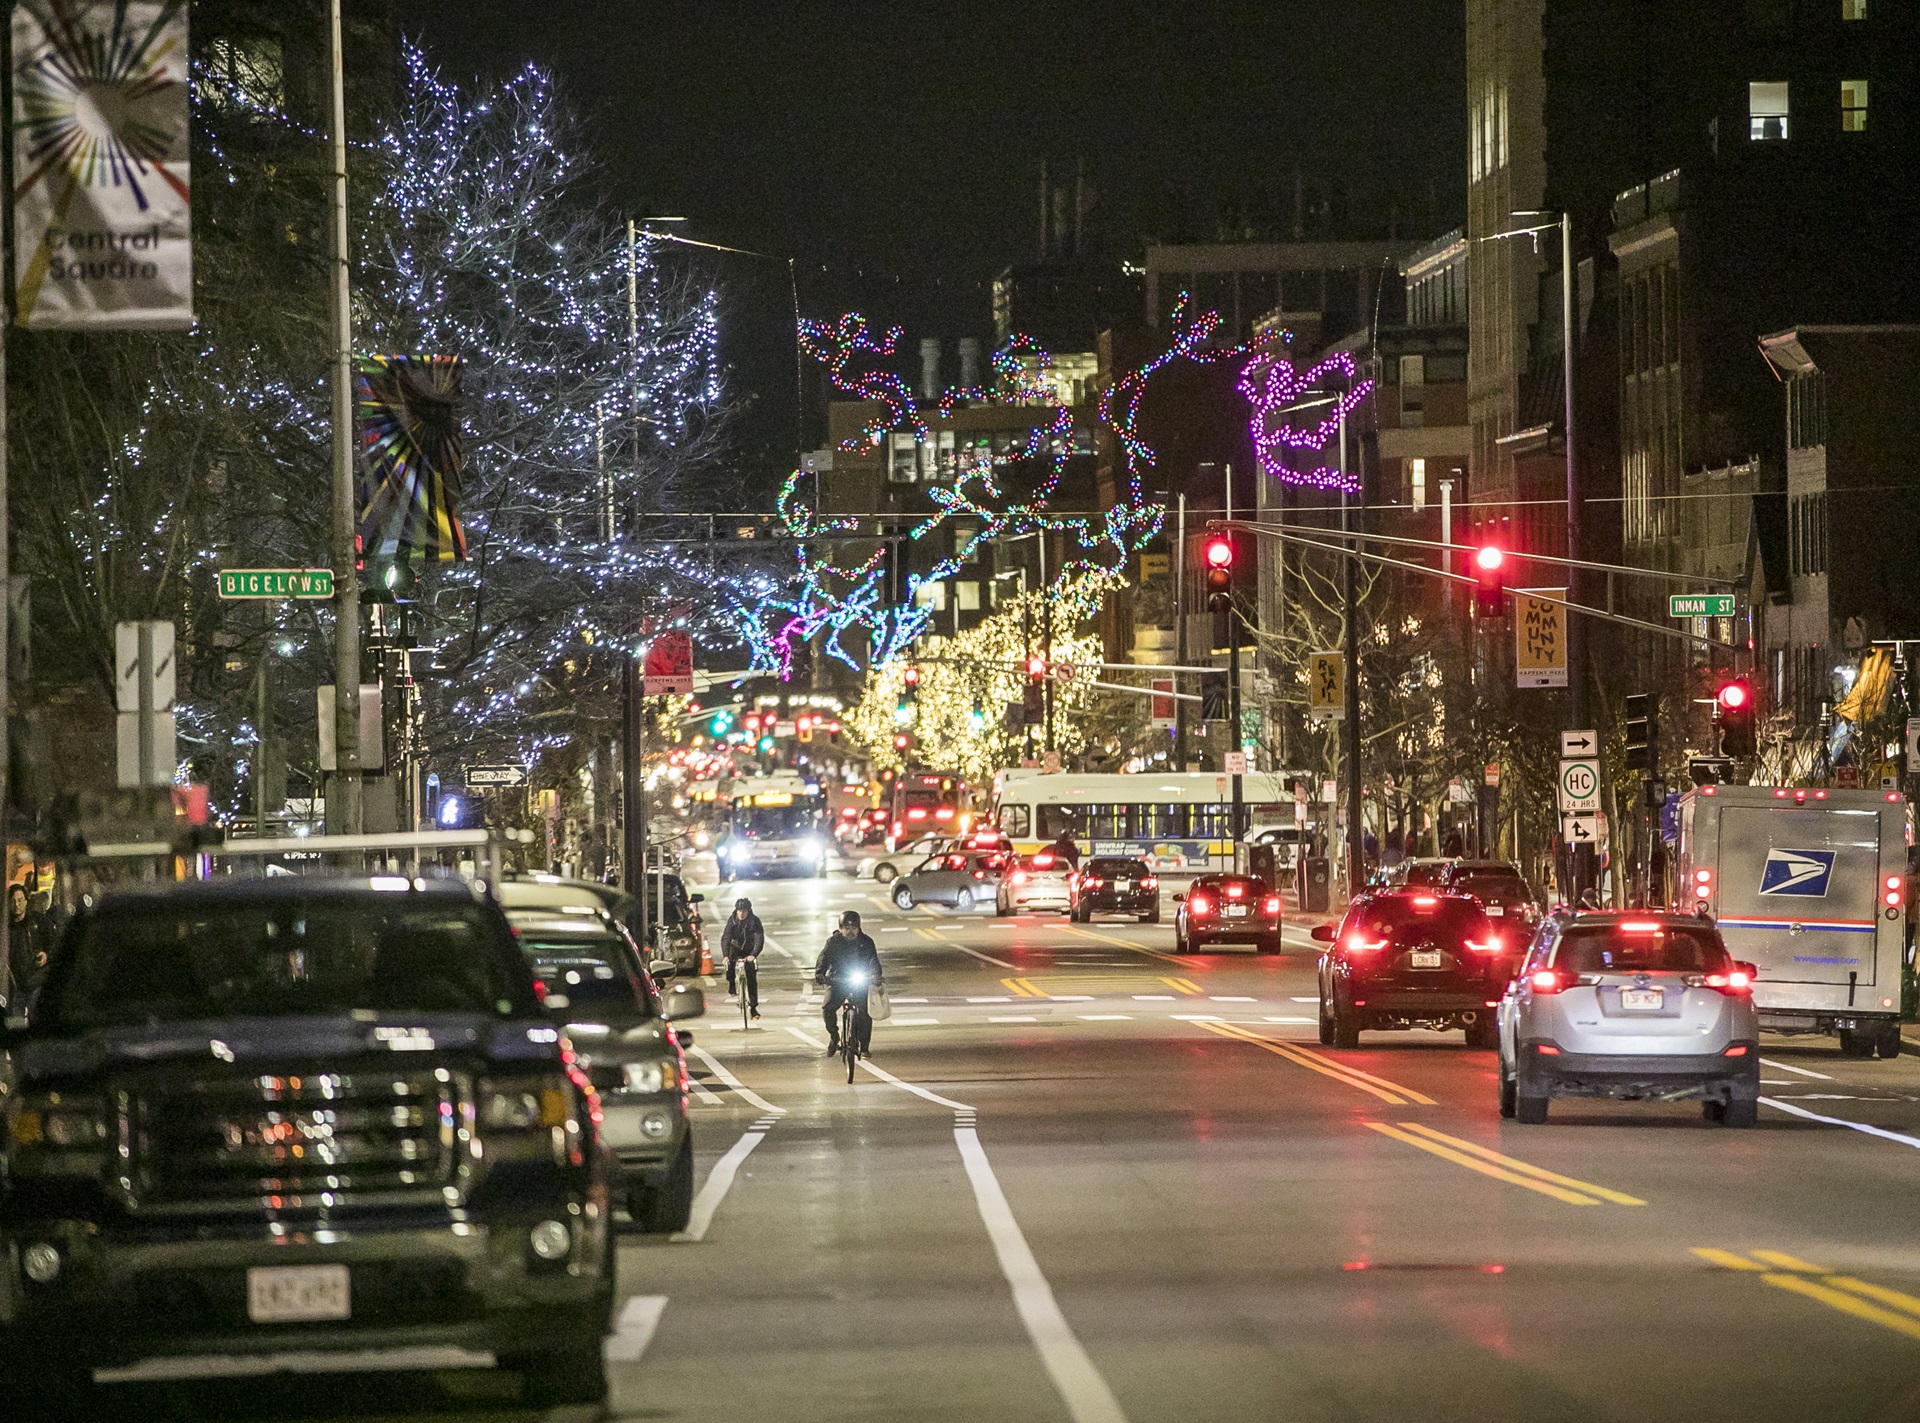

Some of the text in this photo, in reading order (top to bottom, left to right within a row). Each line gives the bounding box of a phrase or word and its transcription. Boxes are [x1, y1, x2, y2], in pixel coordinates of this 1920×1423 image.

[45, 224, 158, 250] Central
[51, 257, 157, 280] Square
[226, 575, 327, 592] BIGELOW ST
[1675, 599, 1731, 613] INMAN ST
[1569, 774, 1590, 790] HC
[1566, 800, 1596, 808] 24 HRS
